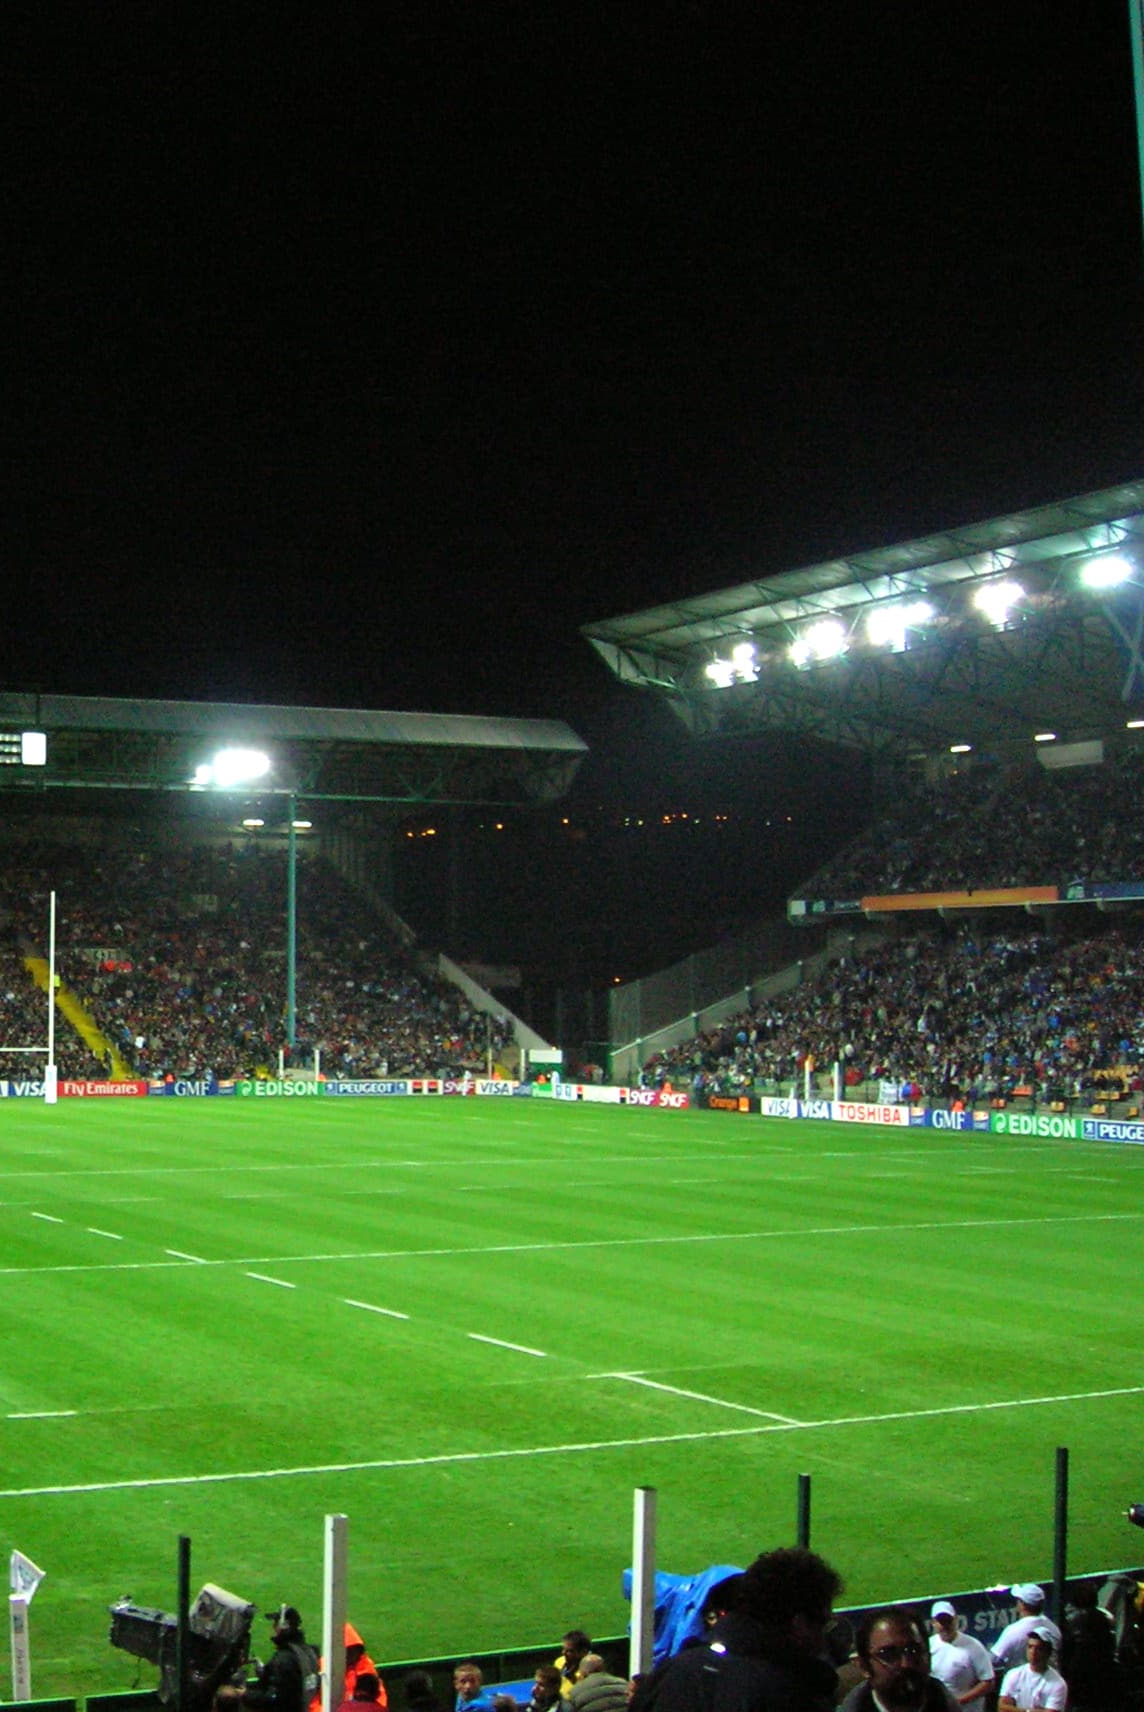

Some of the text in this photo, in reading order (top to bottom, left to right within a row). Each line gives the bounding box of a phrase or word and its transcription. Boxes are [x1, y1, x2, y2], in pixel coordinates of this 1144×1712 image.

[63, 1082, 139, 1096] Fly Emirates
[174, 1081, 210, 1096] GMF
[255, 1081, 318, 1096] EDISON
[339, 1083, 393, 1094] PEUGEOT
[479, 1082, 510, 1094] VISA
[800, 1101, 829, 1119] VISA
[839, 1104, 901, 1123] TOSHIBA
[932, 1109, 965, 1129] GMF
[1008, 1113, 1077, 1138] EDISON
